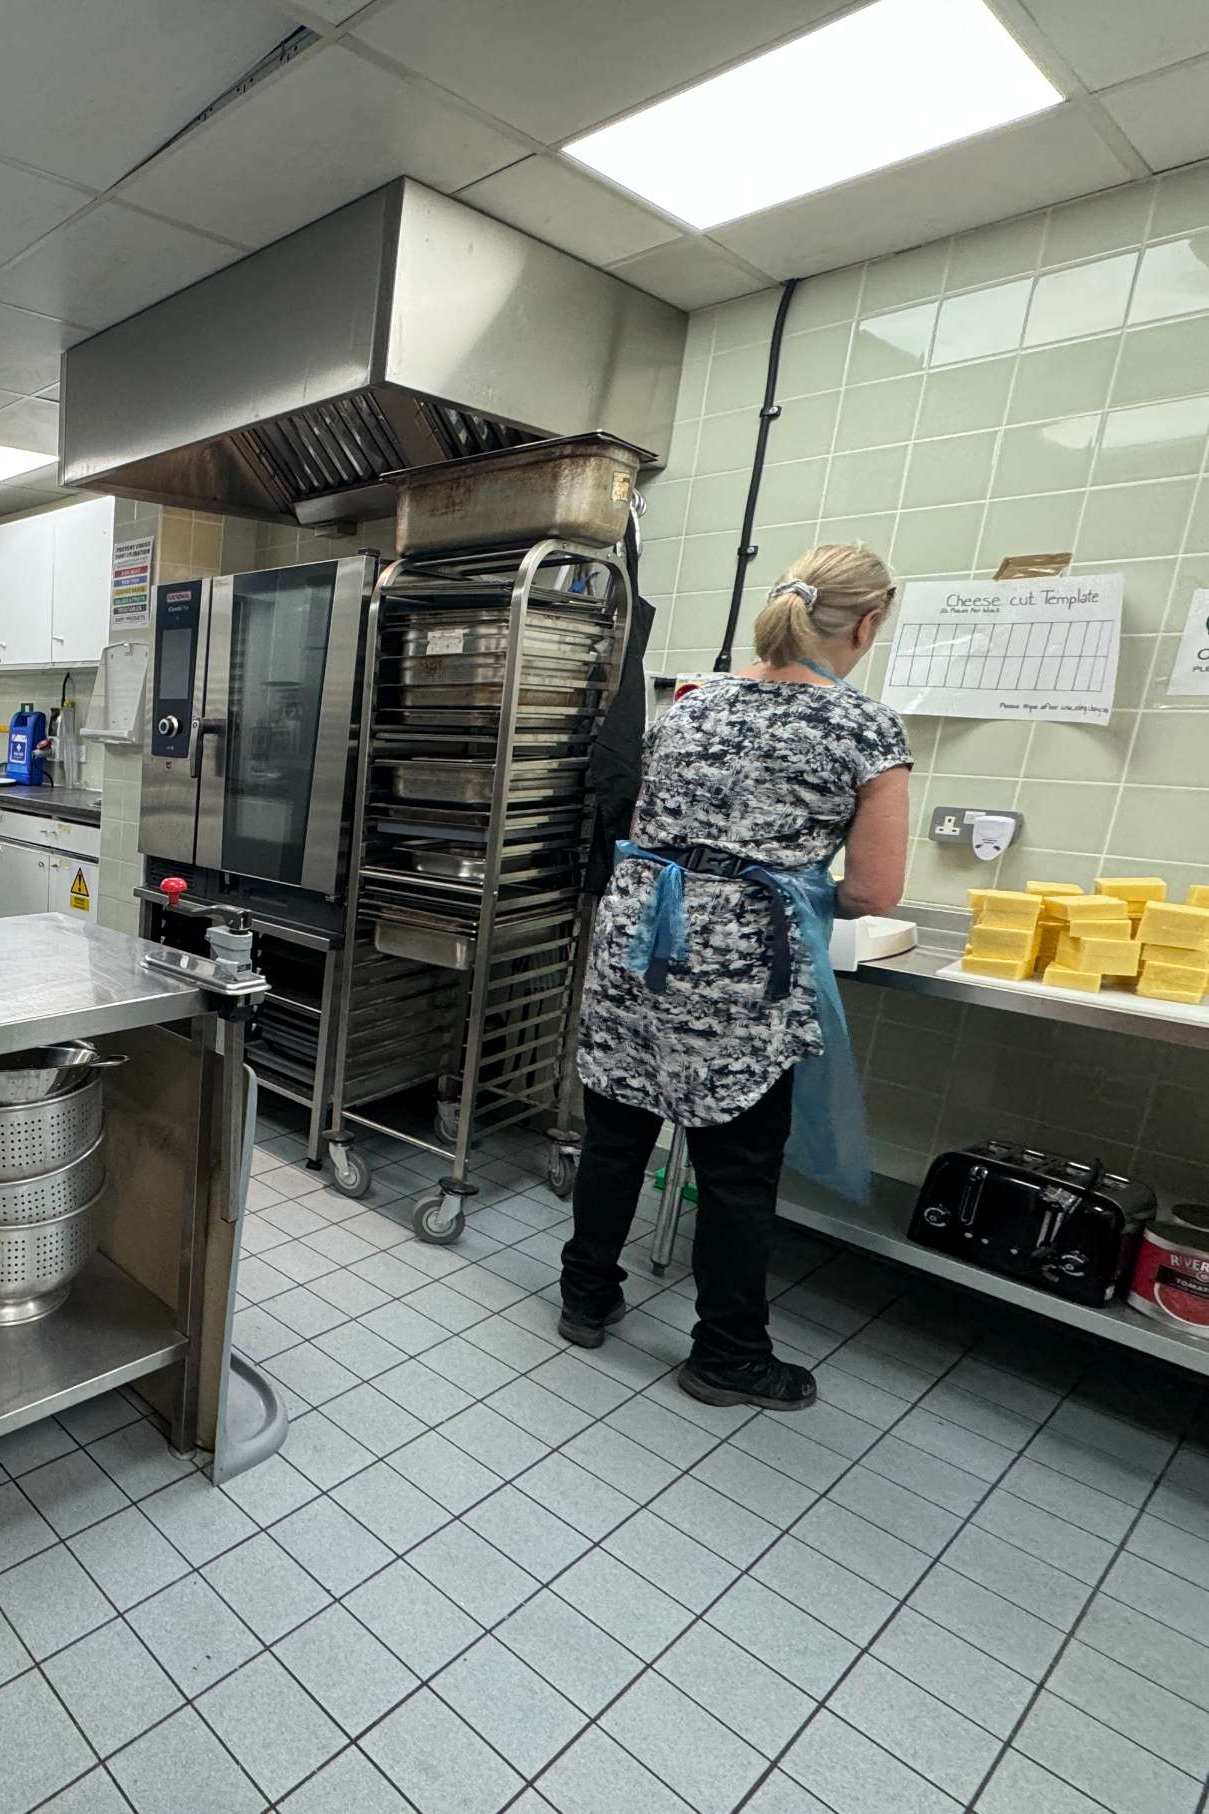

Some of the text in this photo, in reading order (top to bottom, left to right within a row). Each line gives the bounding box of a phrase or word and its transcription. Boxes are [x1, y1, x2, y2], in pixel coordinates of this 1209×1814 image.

[946, 588, 1099, 610] Cheese cut Template
